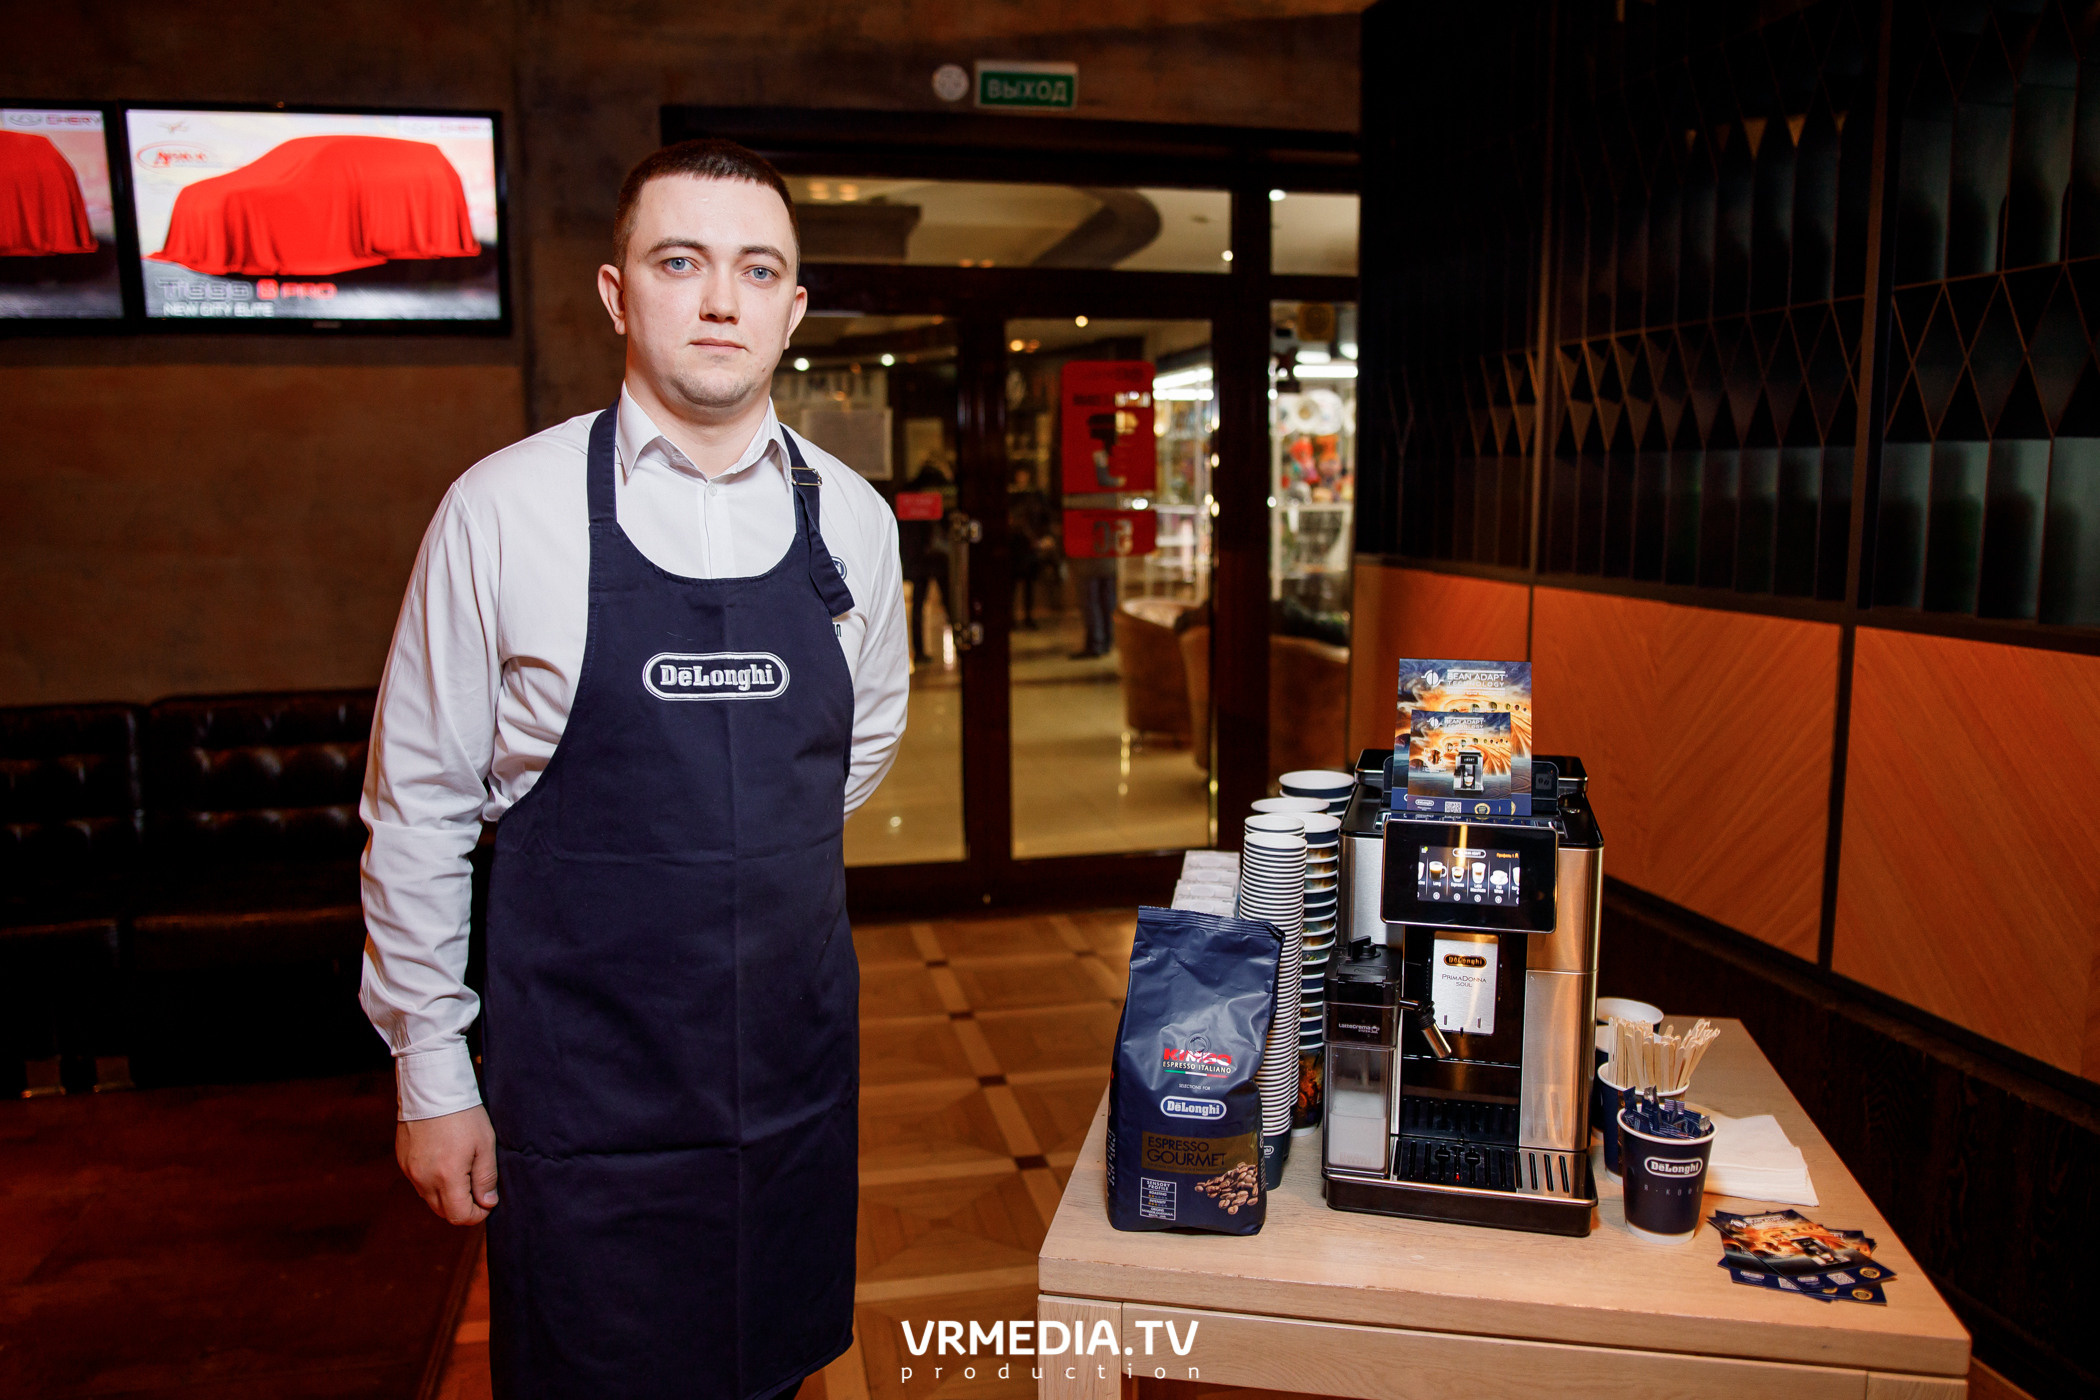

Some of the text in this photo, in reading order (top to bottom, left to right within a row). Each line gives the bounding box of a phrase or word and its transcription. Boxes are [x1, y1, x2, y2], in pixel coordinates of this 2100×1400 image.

[987, 79, 1068, 102] ВЫХОД
[280, 282, 338, 299] PRO
[162, 302, 275, 317] NEW CITY ELITE
[1447, 672, 1472, 681] BEAN
[1162, 1060, 1232, 1074] ESPRESSO ITALIANO
[1147, 1135, 1210, 1153] ESPRESSO
[1146, 1148, 1228, 1168] GOURMET
[1146, 1180, 1171, 1189] SENSORY
[1147, 1184, 1169, 1192] PROFILE
